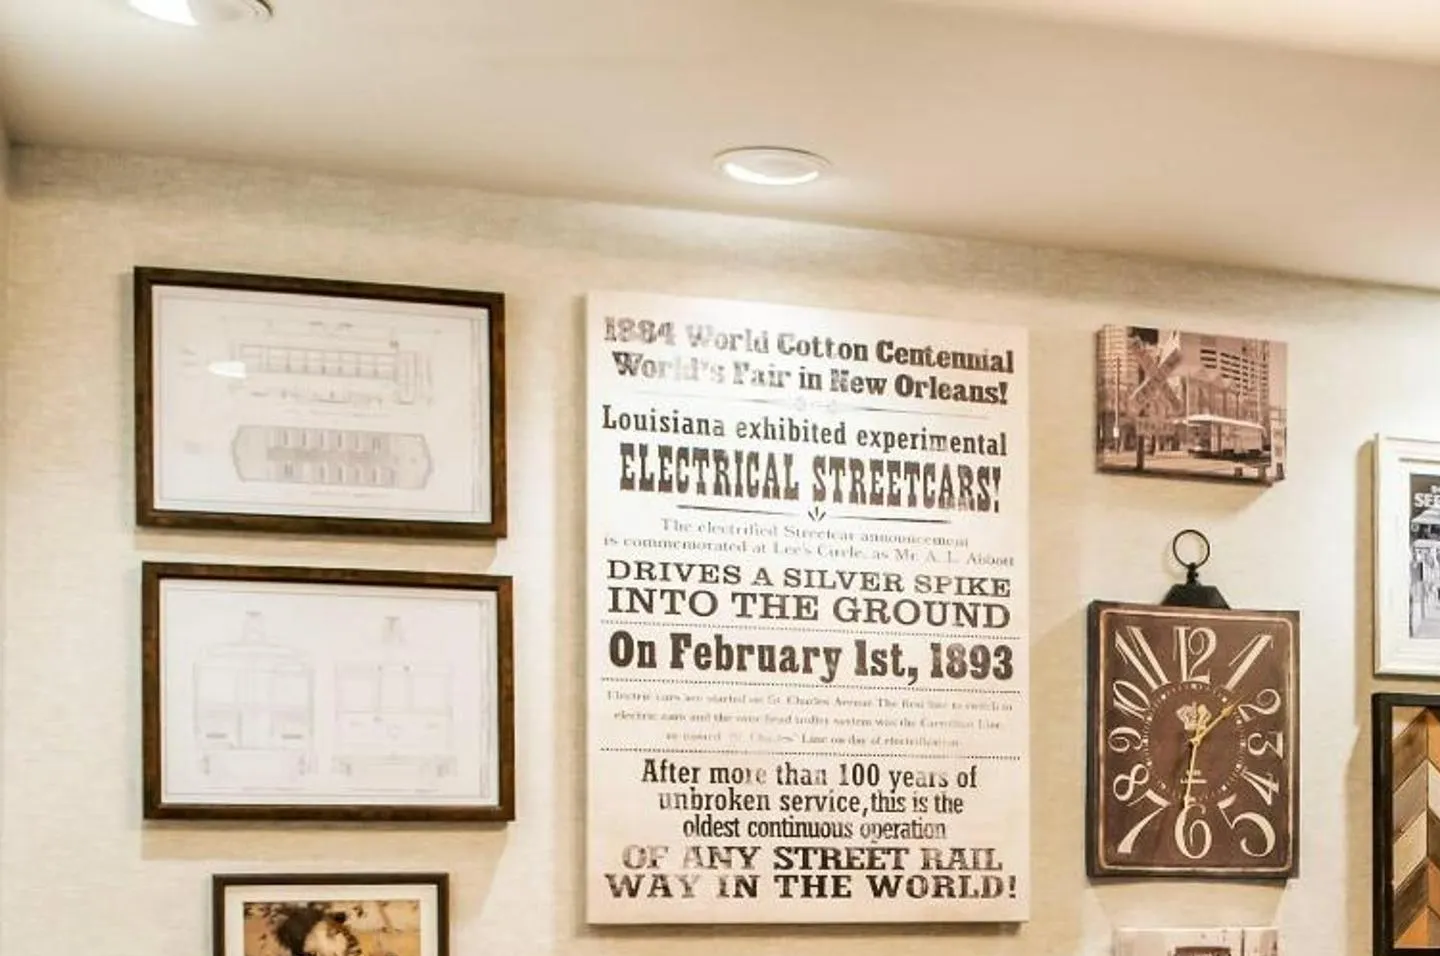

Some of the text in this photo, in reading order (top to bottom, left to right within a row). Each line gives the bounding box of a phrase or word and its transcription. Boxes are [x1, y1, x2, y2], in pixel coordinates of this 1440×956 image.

[684, 323, 769, 354] World
[776, 332, 869, 362] Cotton
[875, 338, 1015, 374] Centennial
[611, 350, 1009, 405] World's Fair in New Orleans!
[602, 405, 1008, 456] Louisiana exhibited experimental
[619, 442, 1002, 513] ELECTRICAL STREETCARS!
[661, 517, 694, 533] The
[606, 559, 1011, 598] DRIVES A SILVER SPIKE
[607, 587, 1011, 630] INTO THE GROUND
[609, 630, 1014, 686] On February 1st, 1893
[1174, 626, 1217, 684] 12
[1237, 688, 1282, 722] 2
[1247, 731, 1284, 760] 3
[641, 758, 978, 794] After more than 100 years of
[1112, 763, 1150, 801] 8
[659, 787, 771, 812] unbroken
[912, 793, 928, 813] is
[934, 793, 965, 815] the
[682, 814, 947, 844] oldest continuous operation
[1115, 789, 1172, 855] 7
[1174, 803, 1213, 859] 6
[1217, 793, 1277, 857] 5
[621, 844, 1004, 872] OF ANY STREET RAIL
[604, 873, 1018, 900] WAY IN THE WORLD!
